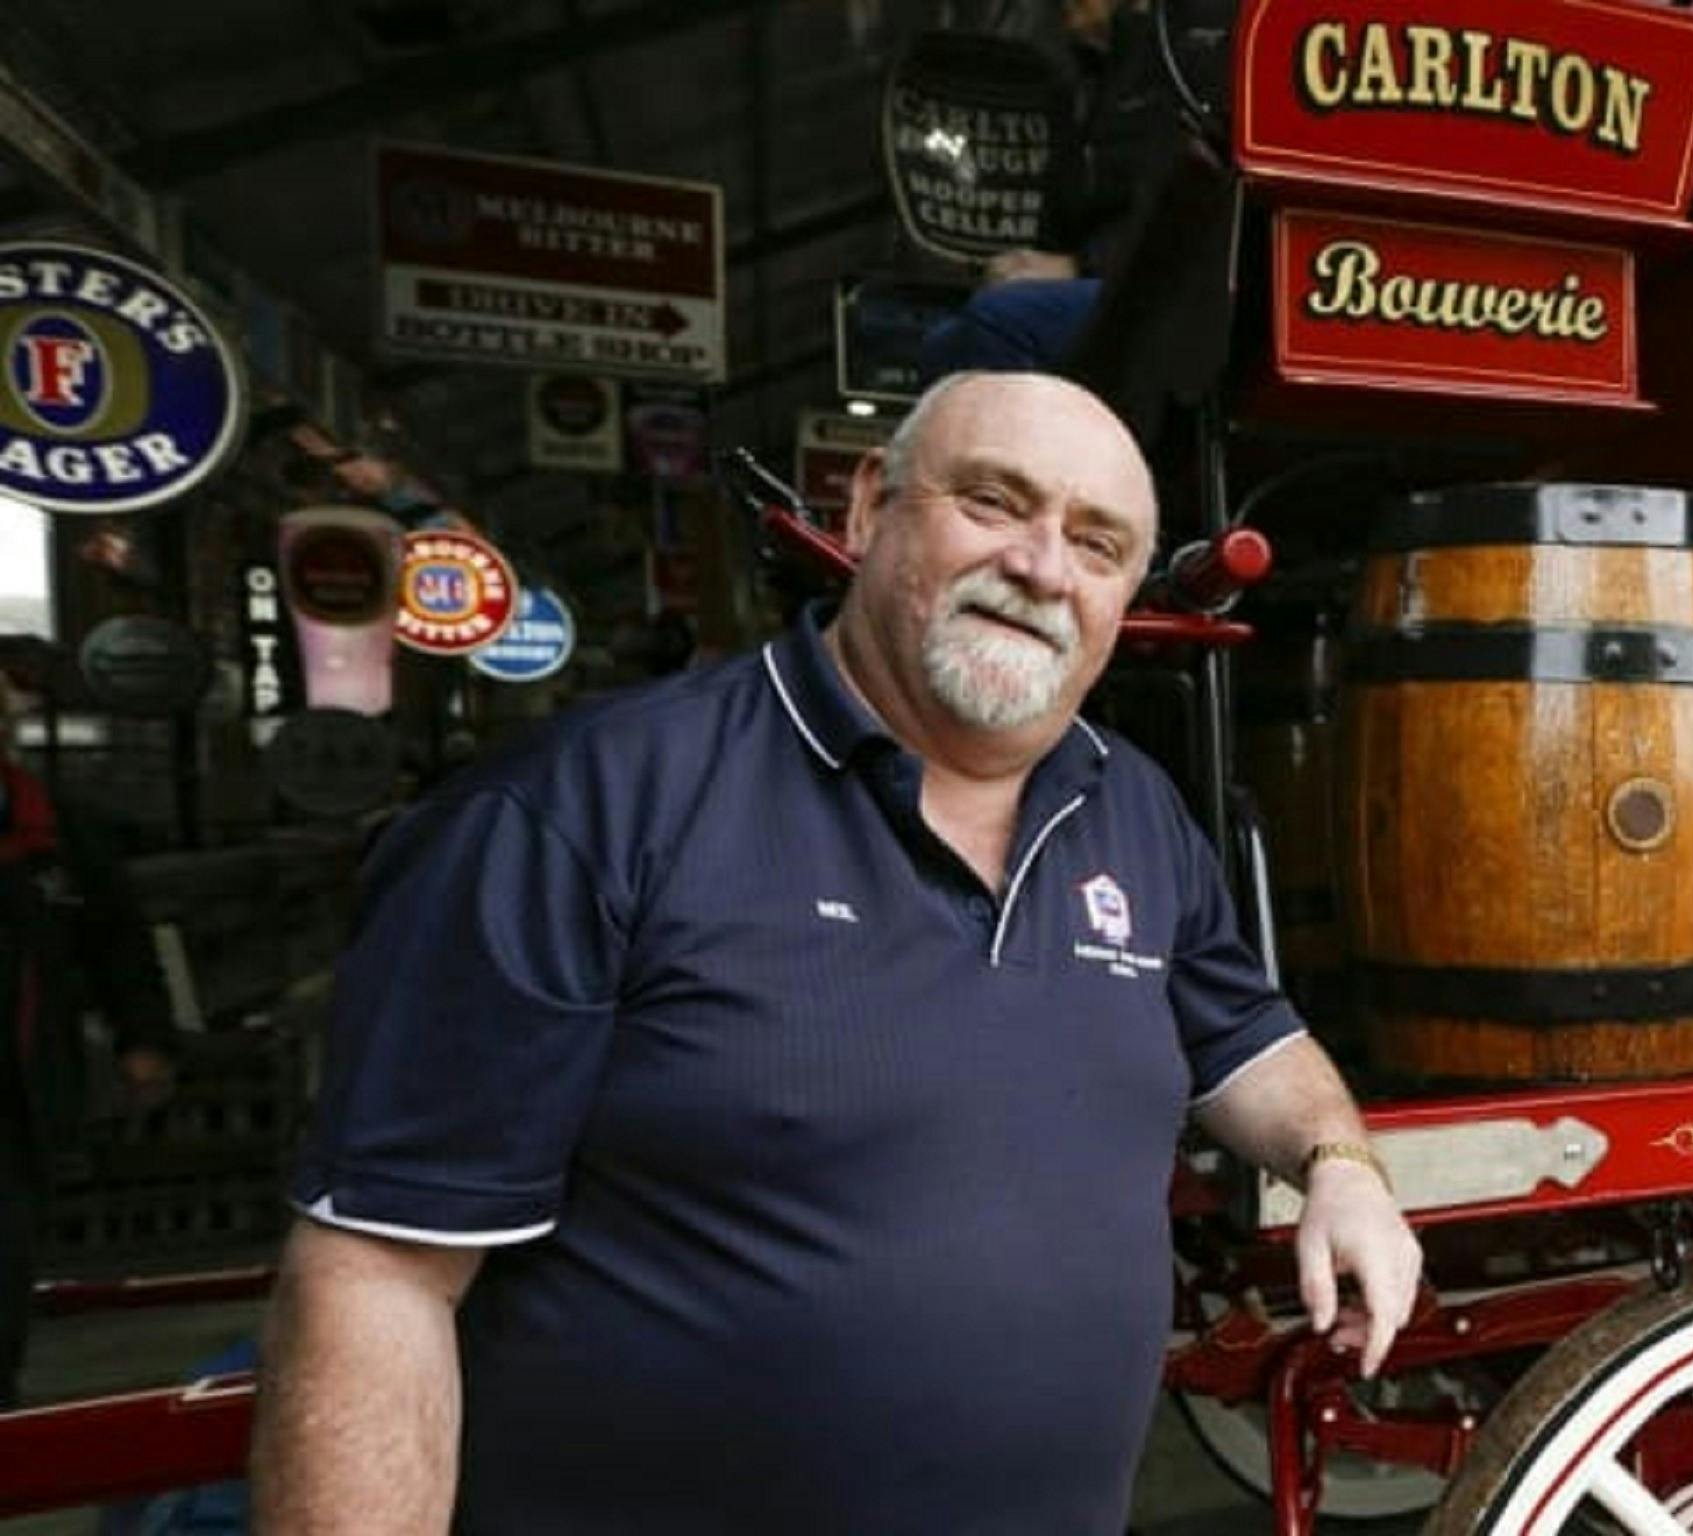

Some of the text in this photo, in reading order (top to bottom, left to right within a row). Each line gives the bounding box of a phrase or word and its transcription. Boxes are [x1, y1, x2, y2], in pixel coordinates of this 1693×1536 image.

[1303, 23, 1650, 151] CARLTON
[474, 192, 704, 245] MELBOURNE
[517, 225, 655, 263] BITTER
[1307, 240, 1609, 342] Bouverie
[20, 335, 95, 407] F
[0, 431, 191, 485] AGER
